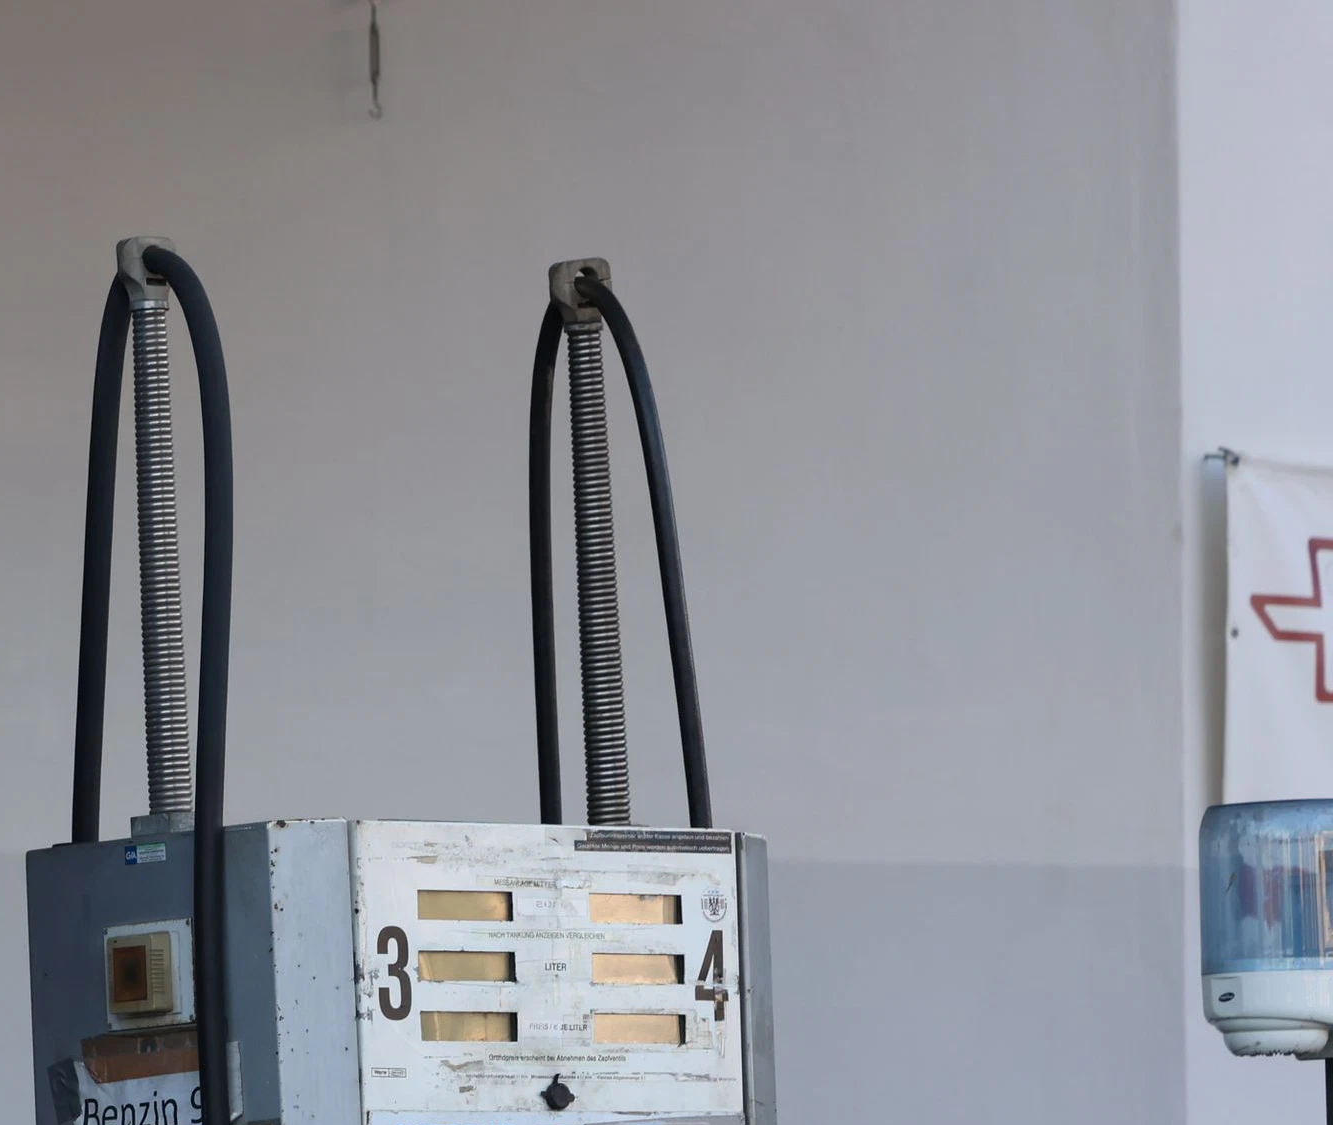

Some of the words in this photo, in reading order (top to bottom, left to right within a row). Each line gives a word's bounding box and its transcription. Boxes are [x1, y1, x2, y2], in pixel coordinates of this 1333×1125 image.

[535, 932, 565, 940] ANZEIGEN
[565, 932, 605, 940] VERGLEICHEN
[545, 962, 567, 972] LITER
[376, 925, 412, 1021] 3
[695, 930, 729, 1022] 4
[557, 1054, 585, 1062] Abnehmen
[597, 1054, 627, 1062] Zapfventils
